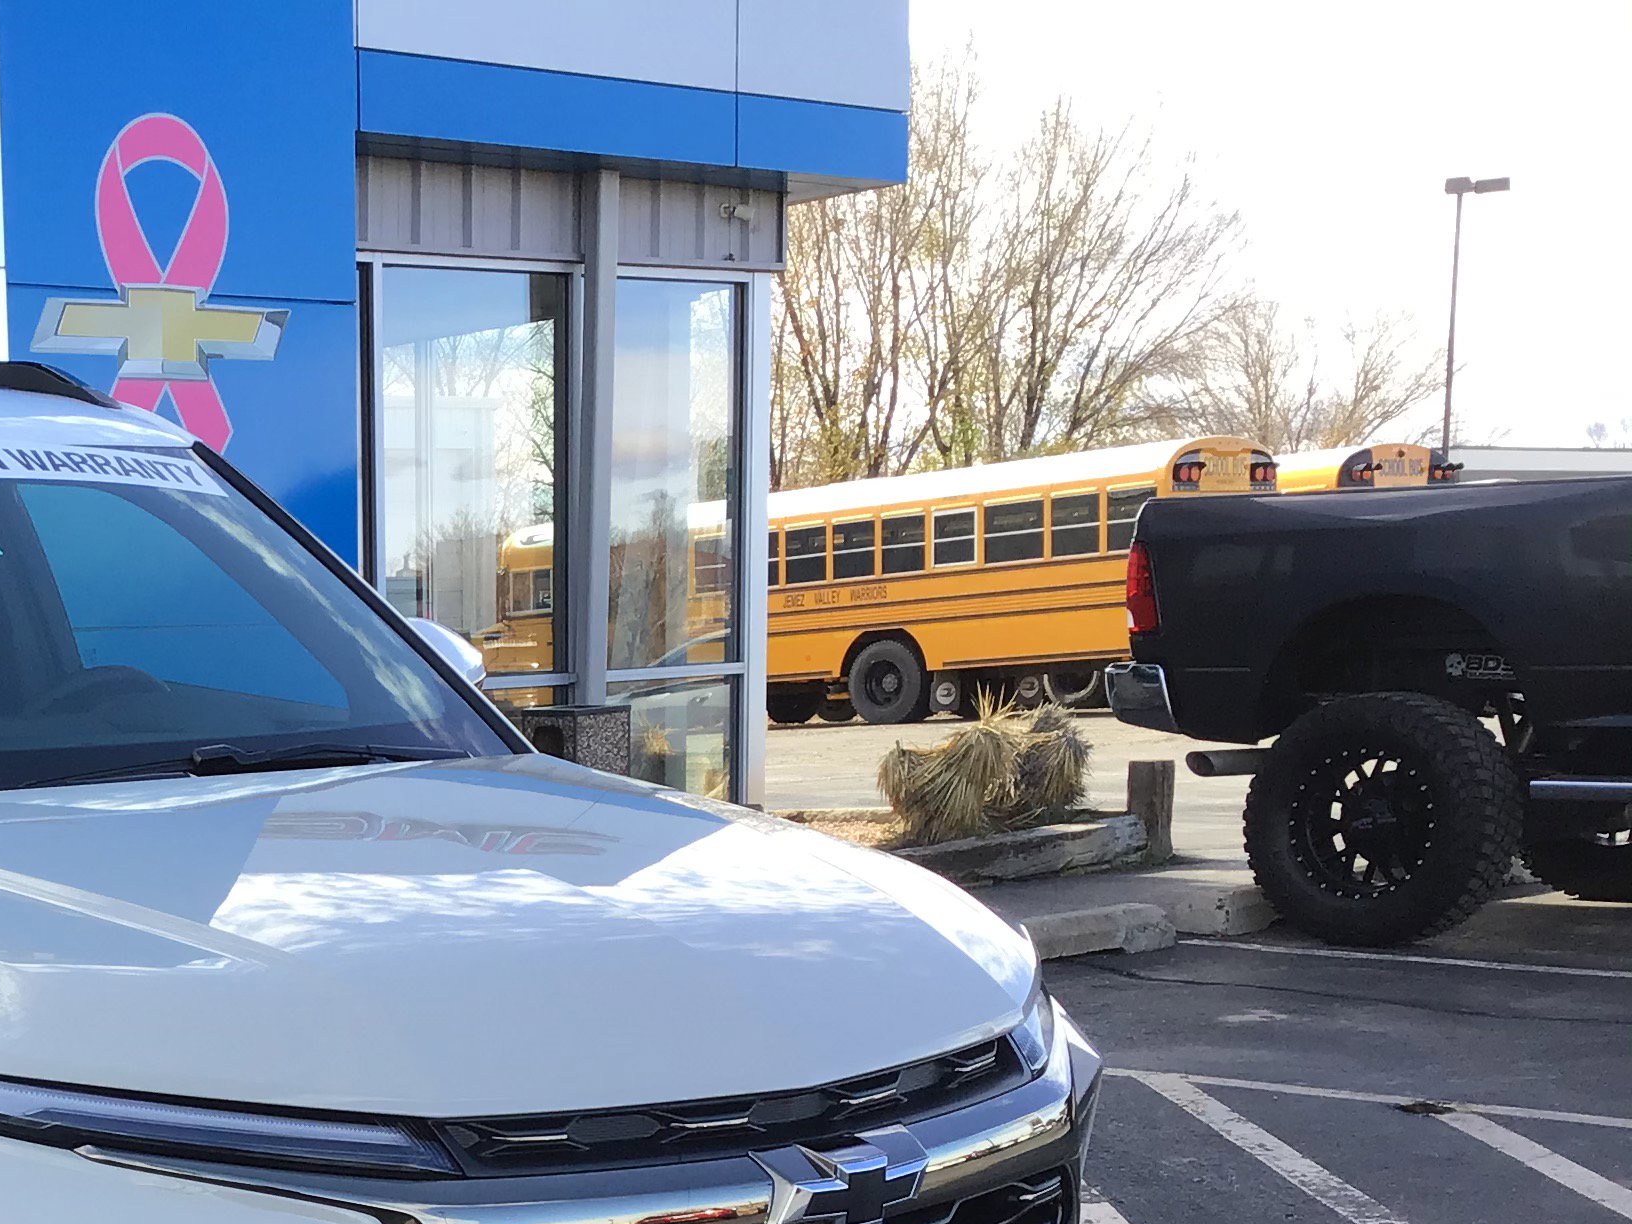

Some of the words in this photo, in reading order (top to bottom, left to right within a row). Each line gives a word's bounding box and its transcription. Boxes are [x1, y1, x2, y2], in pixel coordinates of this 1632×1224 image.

[3, 448, 202, 486] WARRANTY
[1204, 456, 1232, 476] SCHOOL
[1379, 457, 1406, 478] SCHOOL
[1409, 458, 1423, 477] BUS
[783, 594, 805, 608] JEMEZ
[814, 590, 840, 605] VALLEY
[850, 586, 887, 602] WARRIORS
